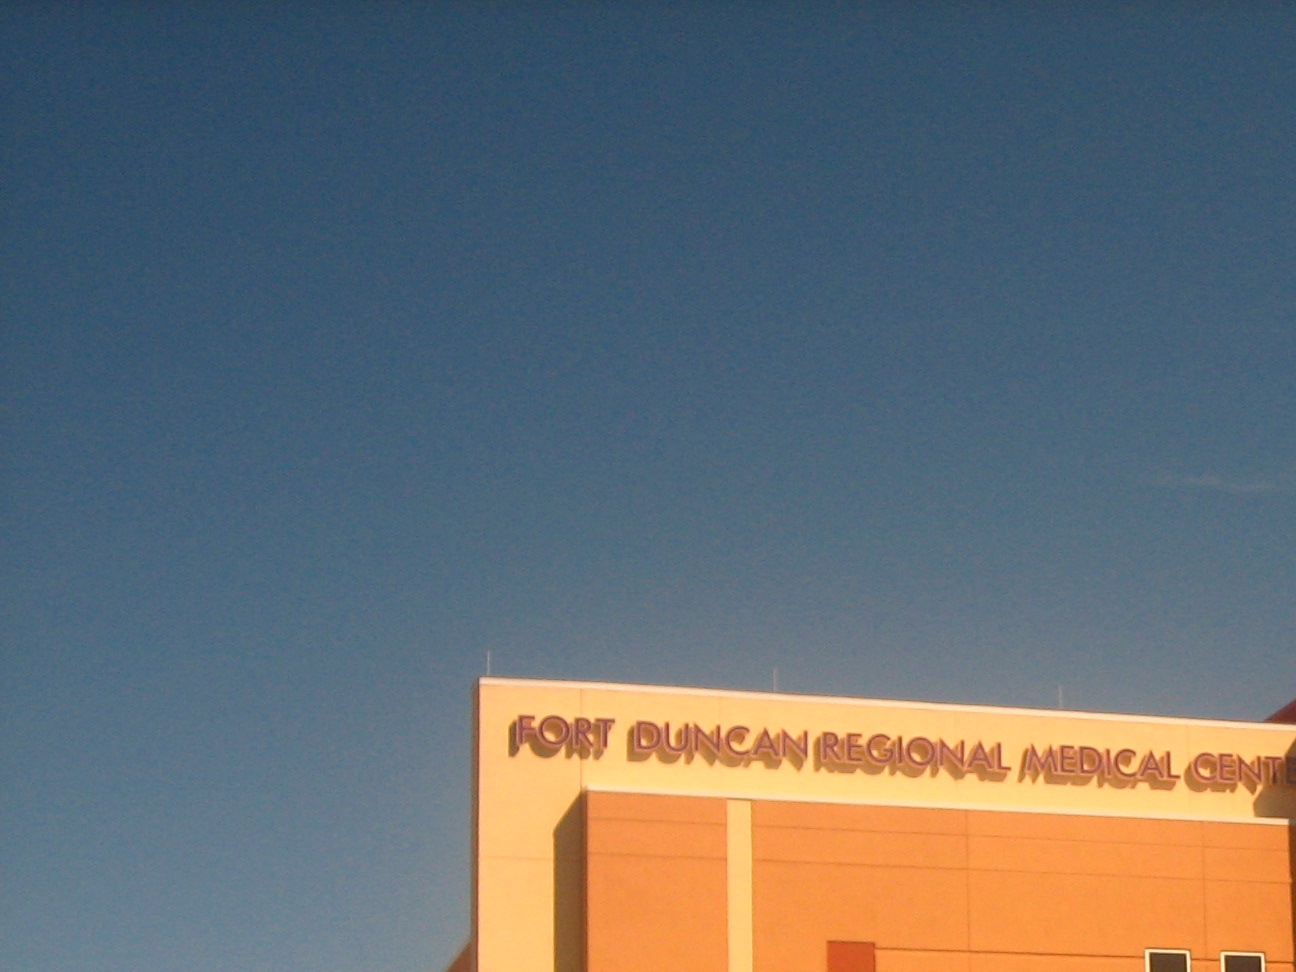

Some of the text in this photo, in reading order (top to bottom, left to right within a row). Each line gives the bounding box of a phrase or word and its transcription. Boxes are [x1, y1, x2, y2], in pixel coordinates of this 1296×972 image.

[515, 714, 616, 749] FORT
[633, 720, 810, 759] DUNCAN
[820, 731, 1012, 771] REGIONAL
[1025, 743, 1181, 781] MEDICAL
